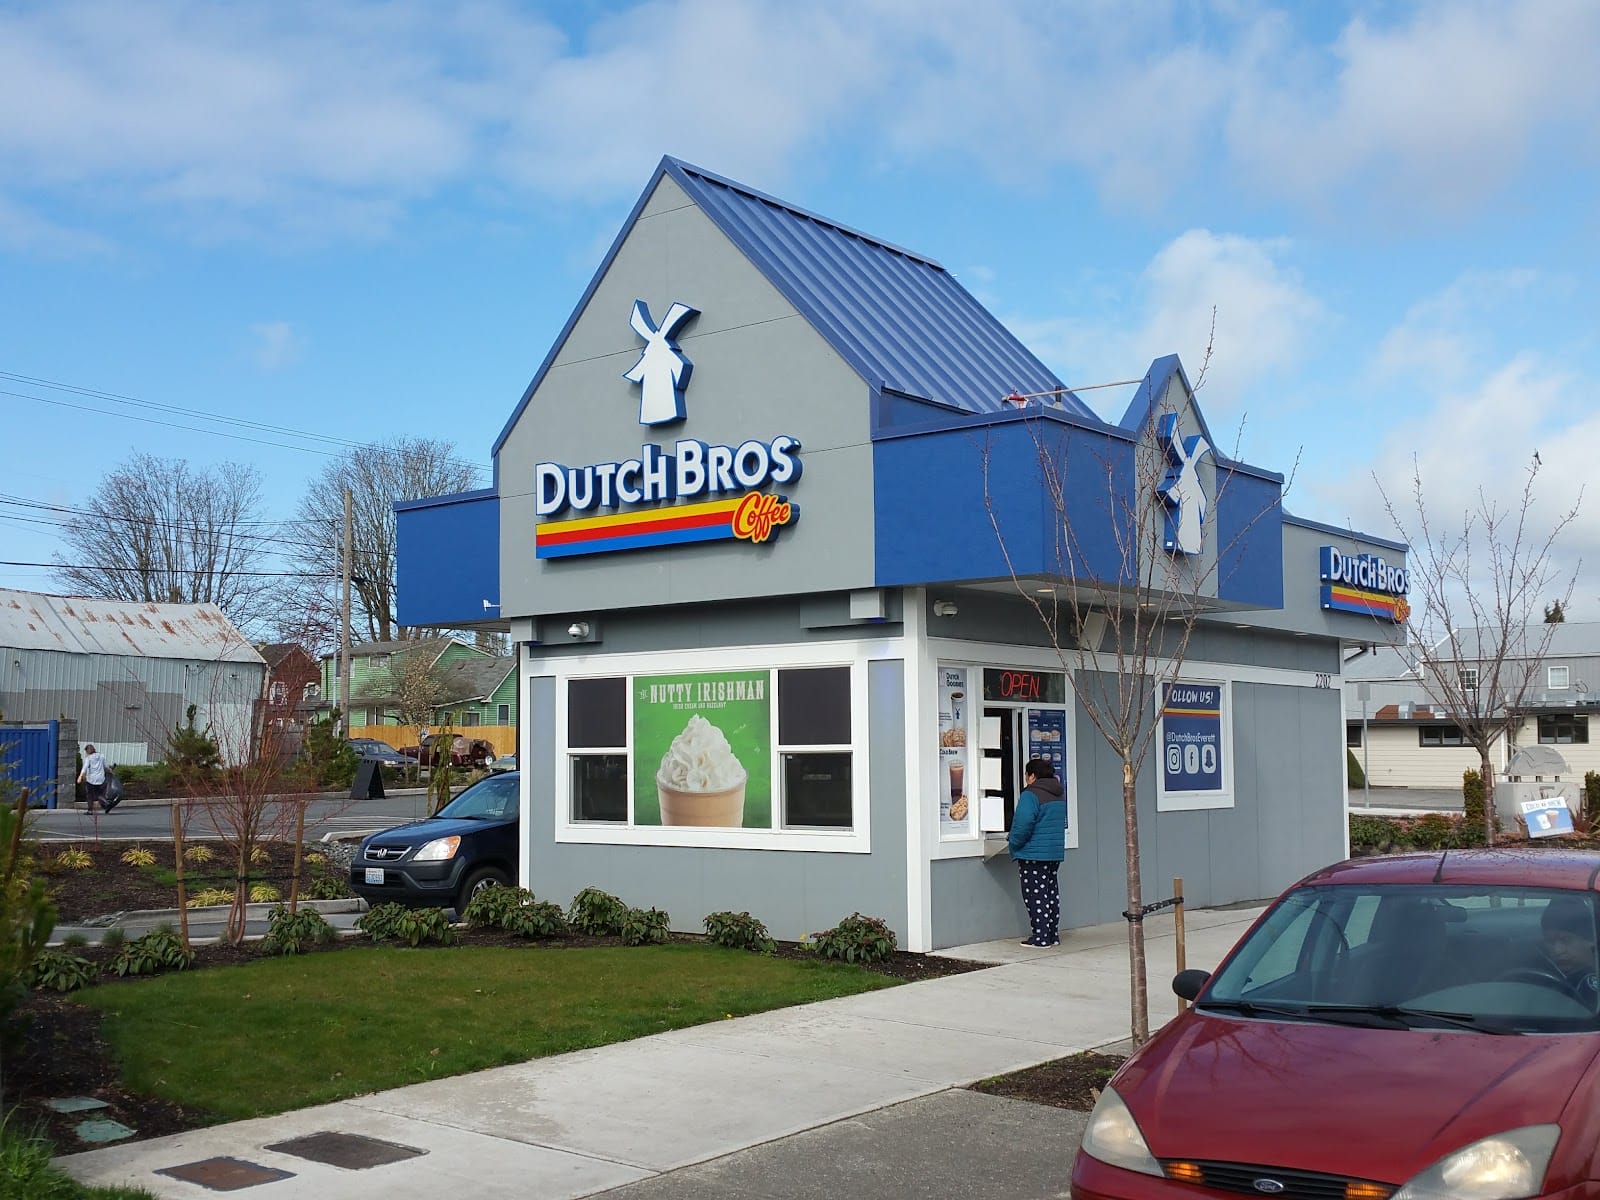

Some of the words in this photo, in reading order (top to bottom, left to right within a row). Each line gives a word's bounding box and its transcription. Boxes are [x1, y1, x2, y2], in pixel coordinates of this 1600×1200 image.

[535, 443, 675, 516] DUTCH
[676, 435, 801, 496] BROS
[732, 491, 792, 543] Coffee
[650, 683, 692, 704] NUTTY
[697, 679, 764, 702] IRISHMAN
[1001, 672, 1040, 698] OPEN
[1171, 689, 1198, 703] OLLOW
[1199, 691, 1214, 704] US!
